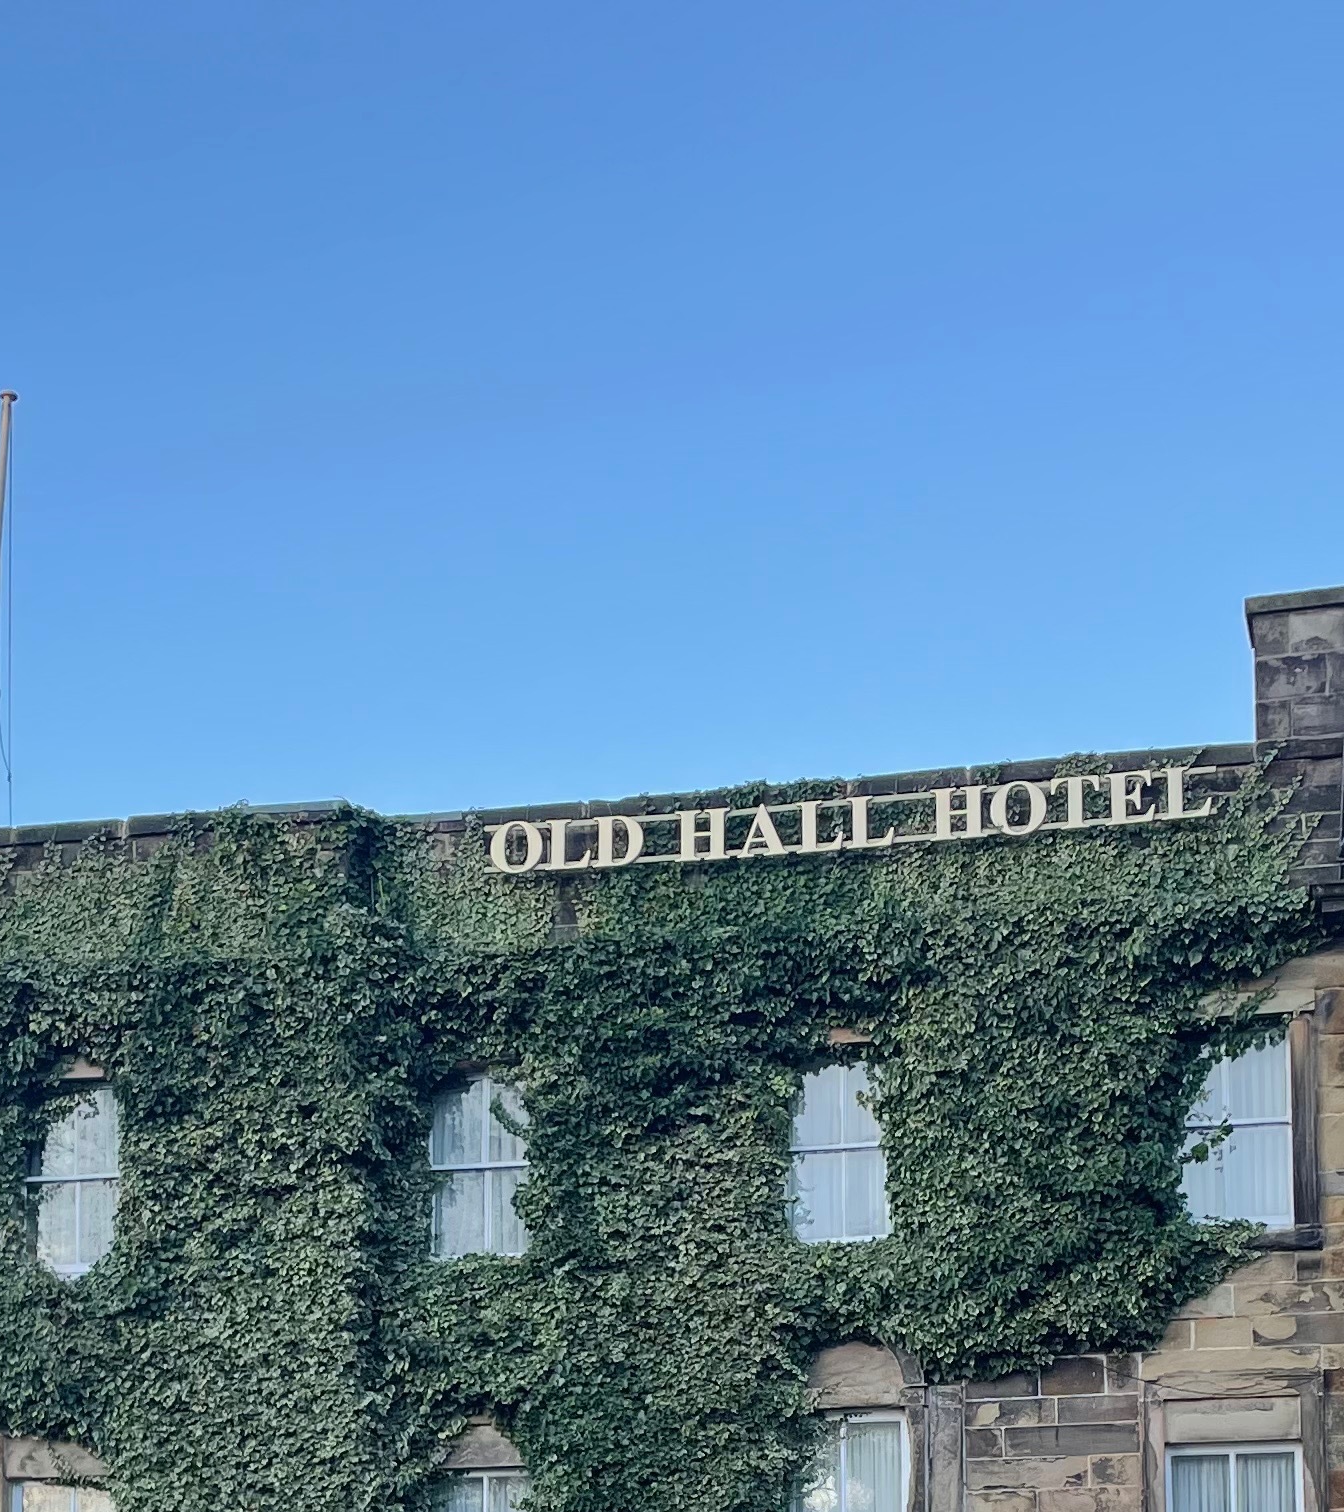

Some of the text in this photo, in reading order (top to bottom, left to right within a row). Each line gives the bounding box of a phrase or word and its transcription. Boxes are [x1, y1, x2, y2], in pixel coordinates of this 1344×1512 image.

[490, 765, 1214, 874] OLD HALL HOTEL
